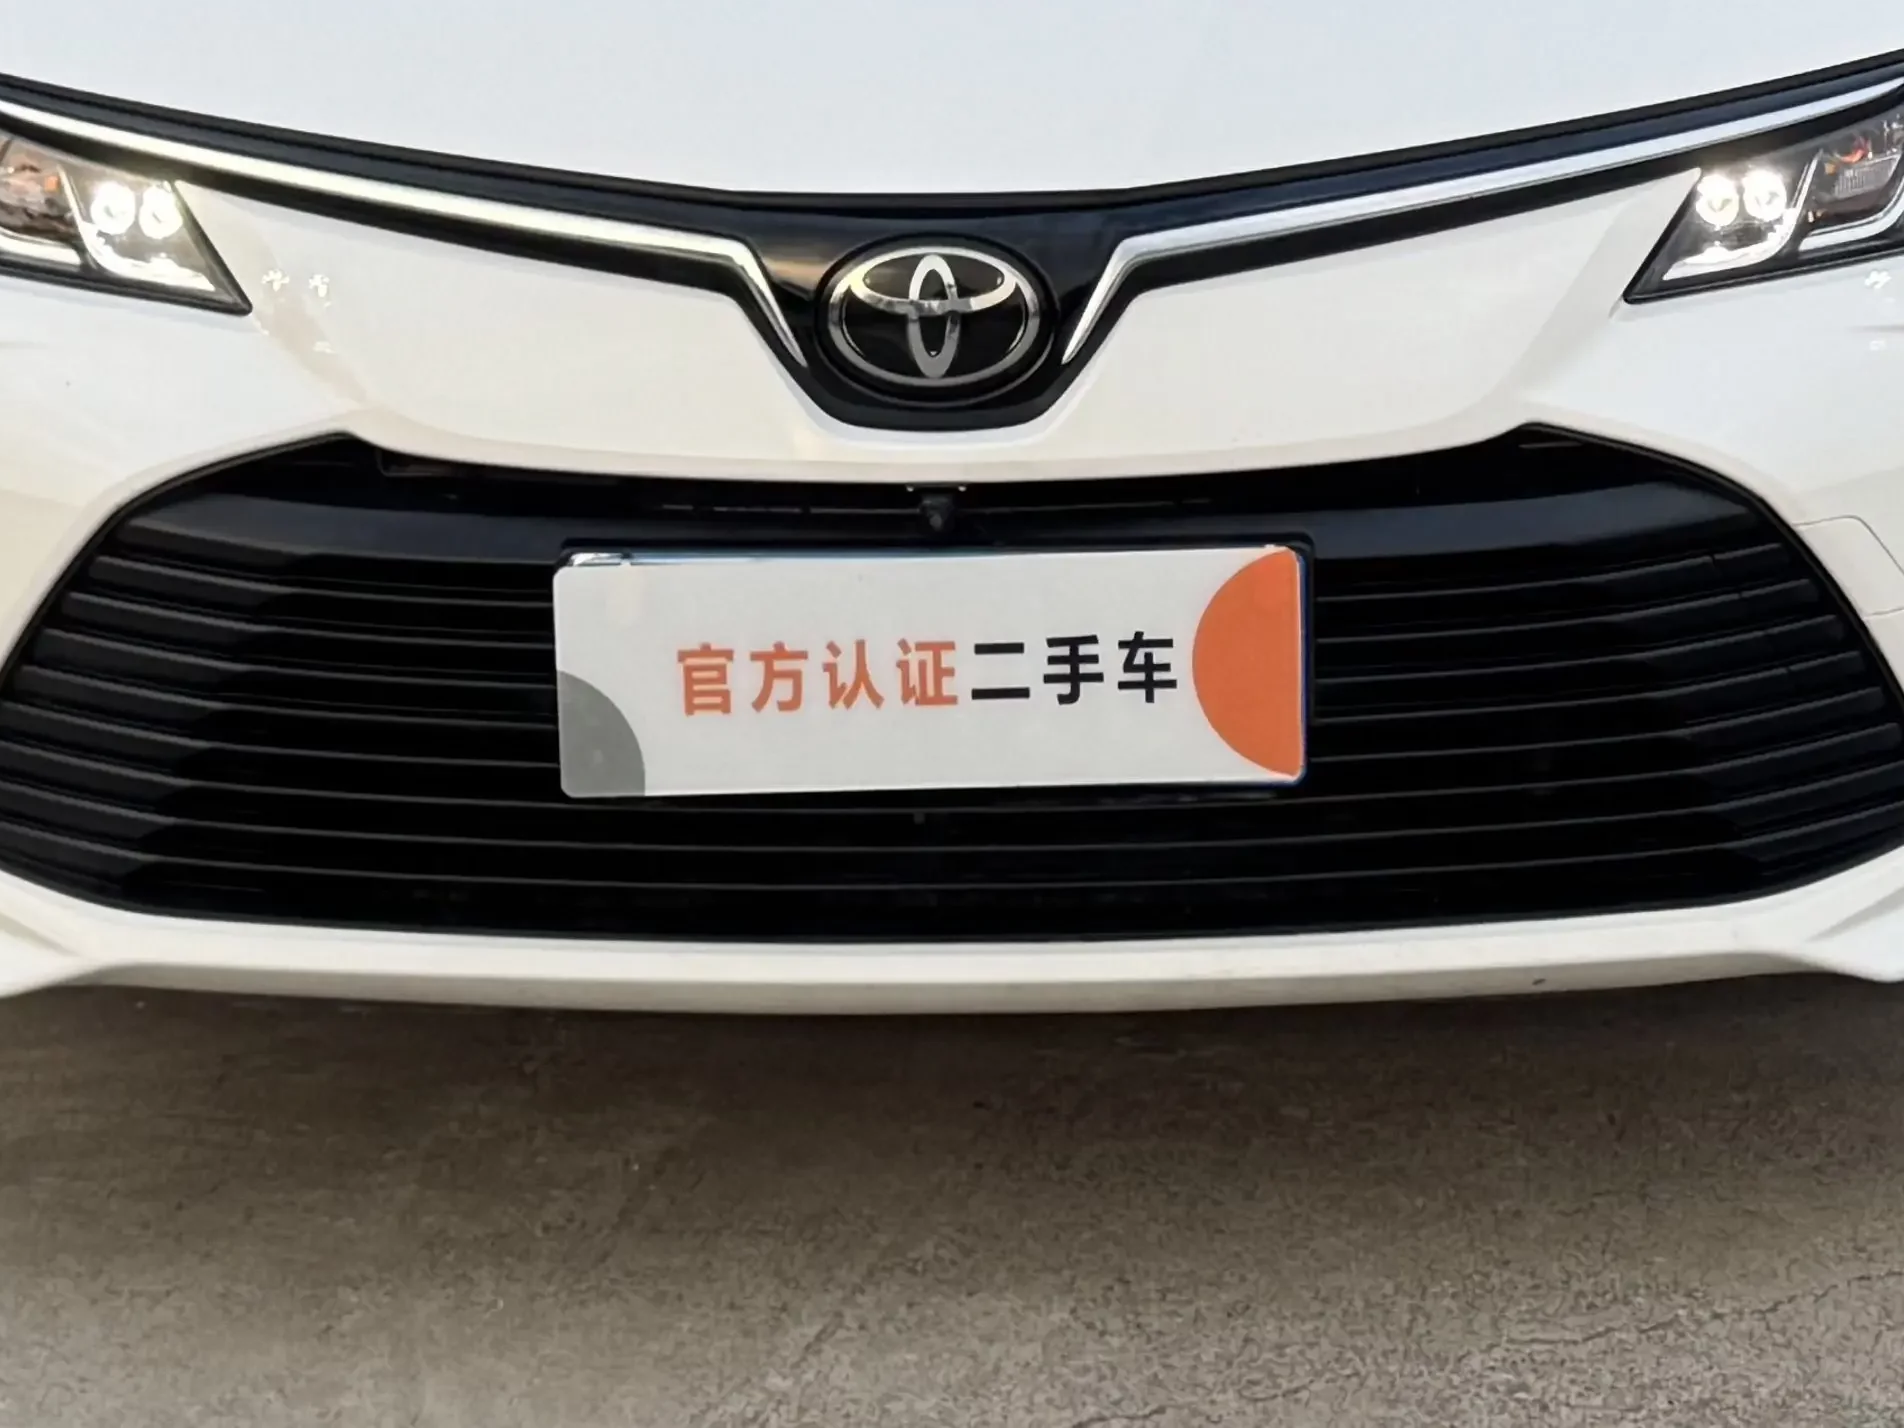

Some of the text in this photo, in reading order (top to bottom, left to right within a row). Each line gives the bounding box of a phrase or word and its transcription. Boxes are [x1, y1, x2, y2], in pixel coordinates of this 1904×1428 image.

[677, 631, 1177, 716] 官方认证二手车
